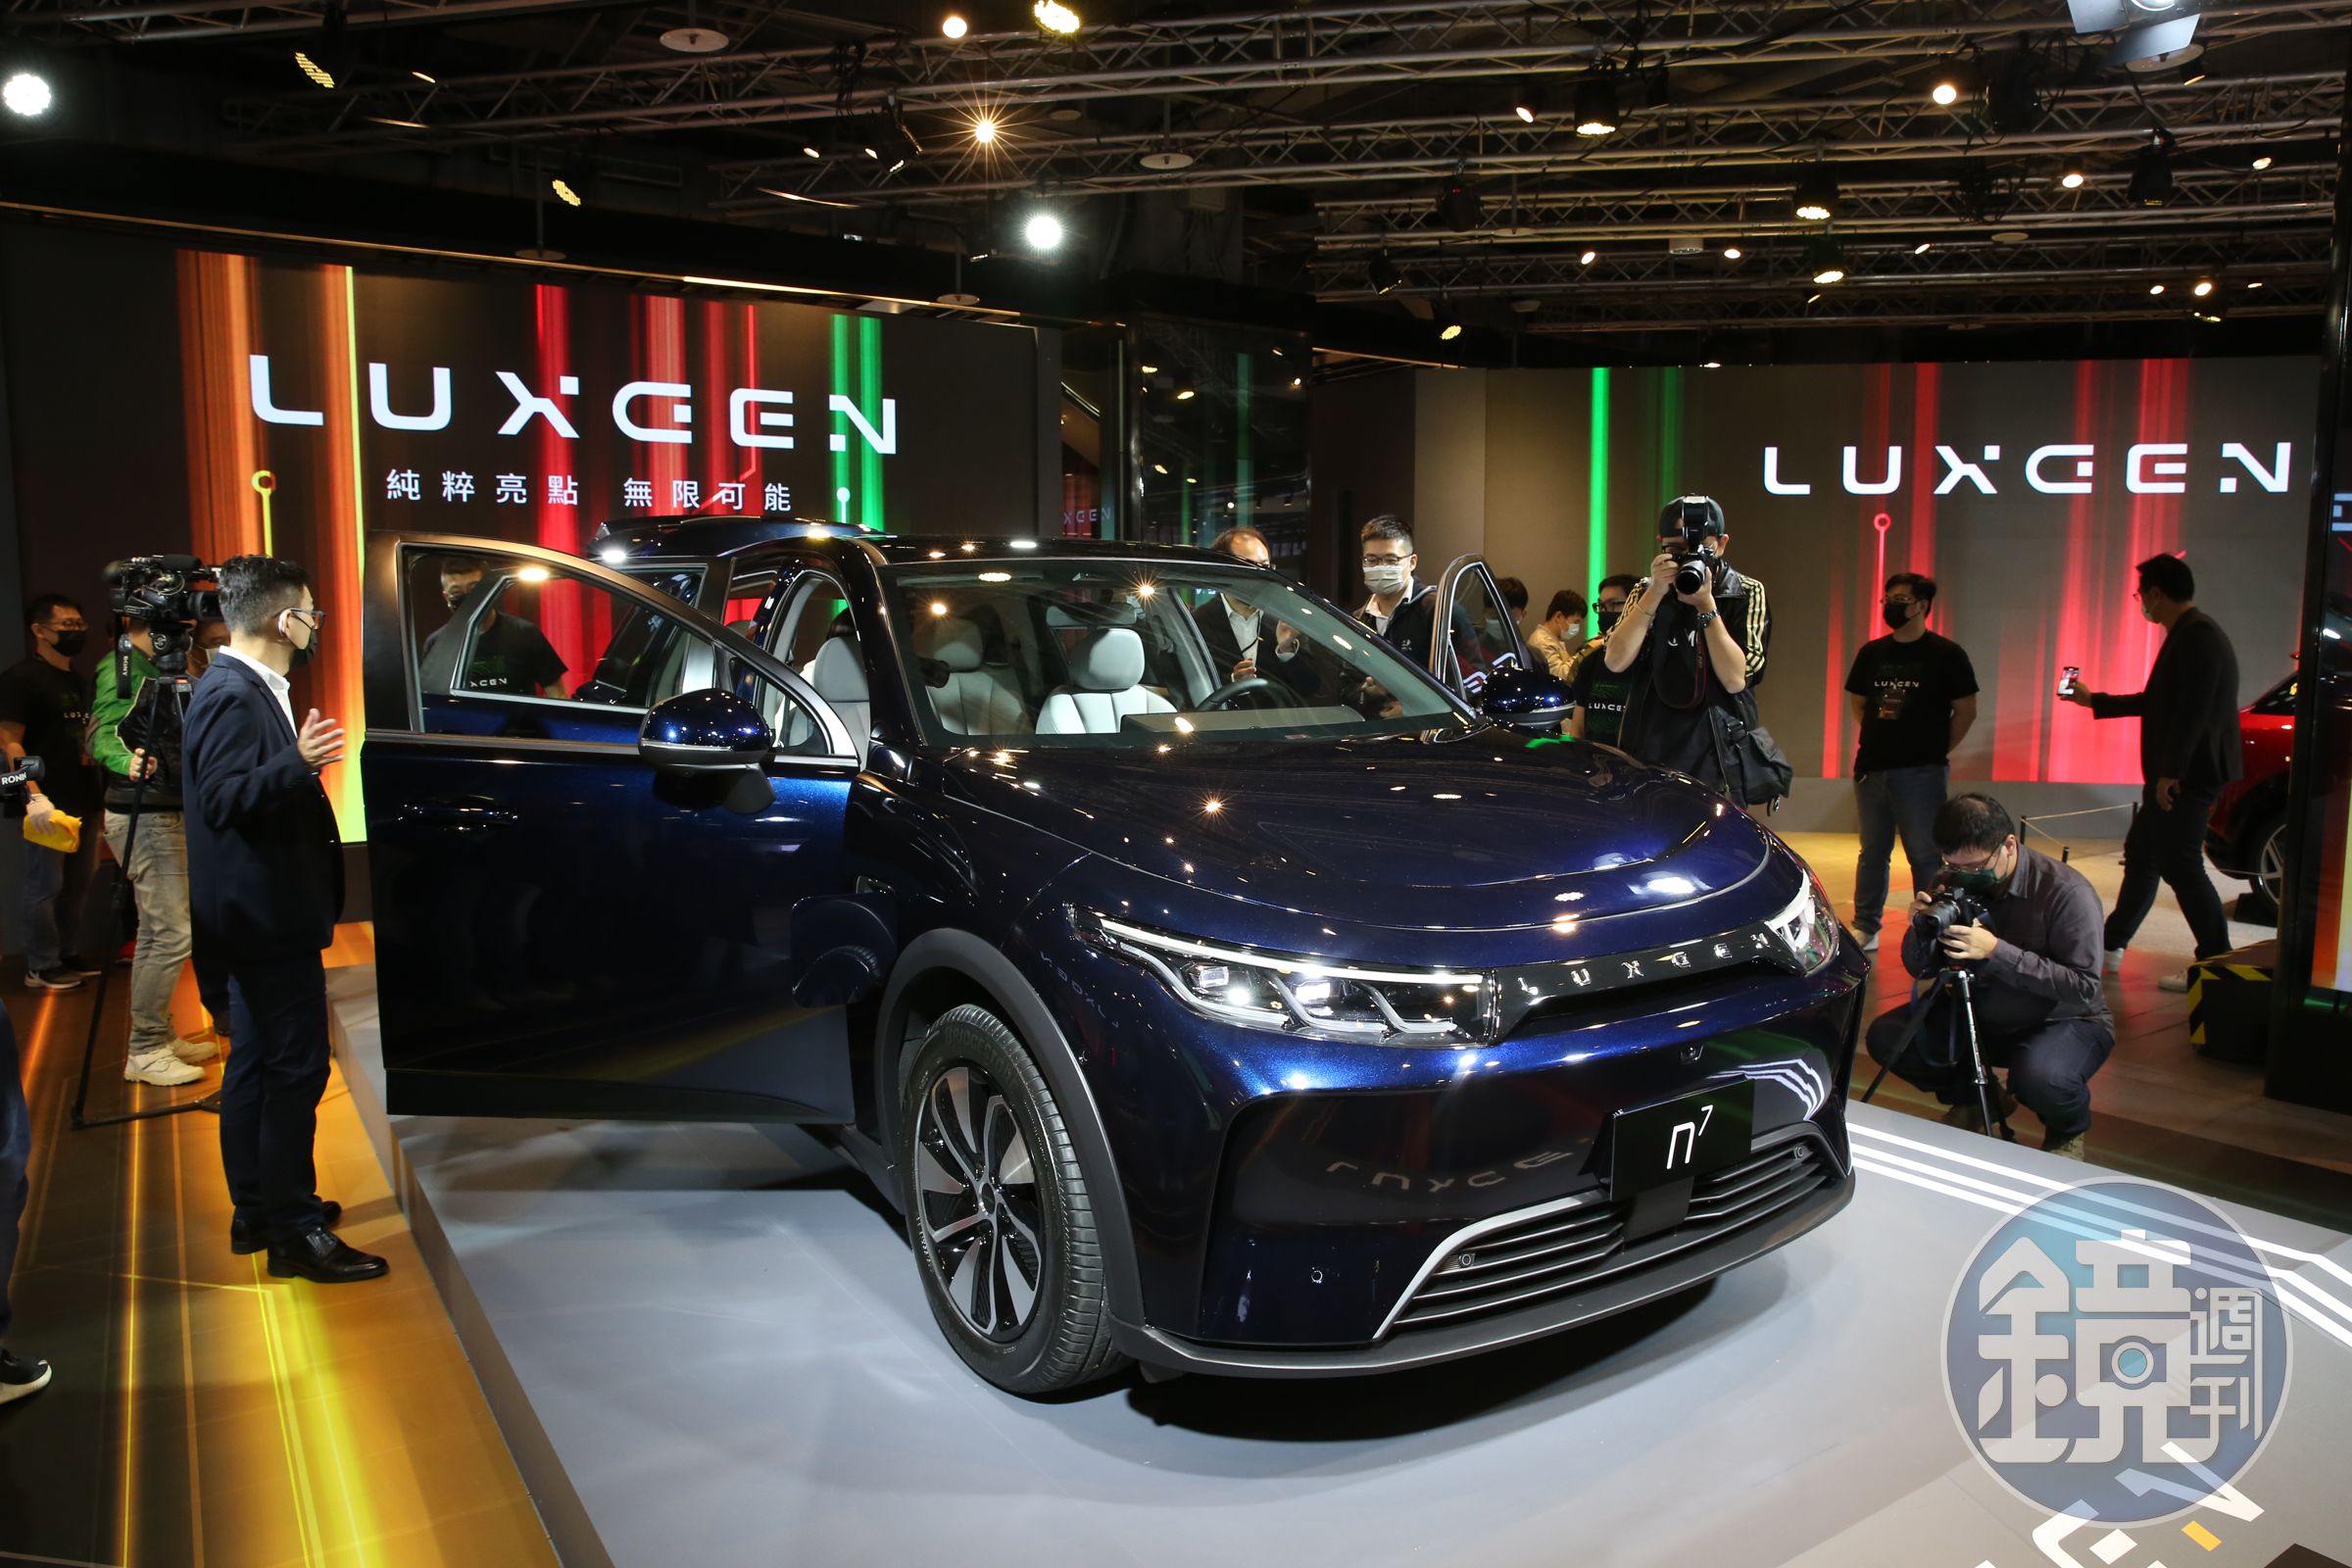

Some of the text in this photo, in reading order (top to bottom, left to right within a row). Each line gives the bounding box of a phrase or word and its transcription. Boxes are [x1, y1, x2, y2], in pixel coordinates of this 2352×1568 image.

[250, 355, 896, 454] LUXGEN
[386, 468, 792, 512] 純粹亮點 無限可能
[1764, 442, 2292, 495] LUXGEN
[1062, 507, 1112, 524] XGEN
[470, 677, 508, 688] XGEN
[1518, 932, 1771, 997] LUXGEN
